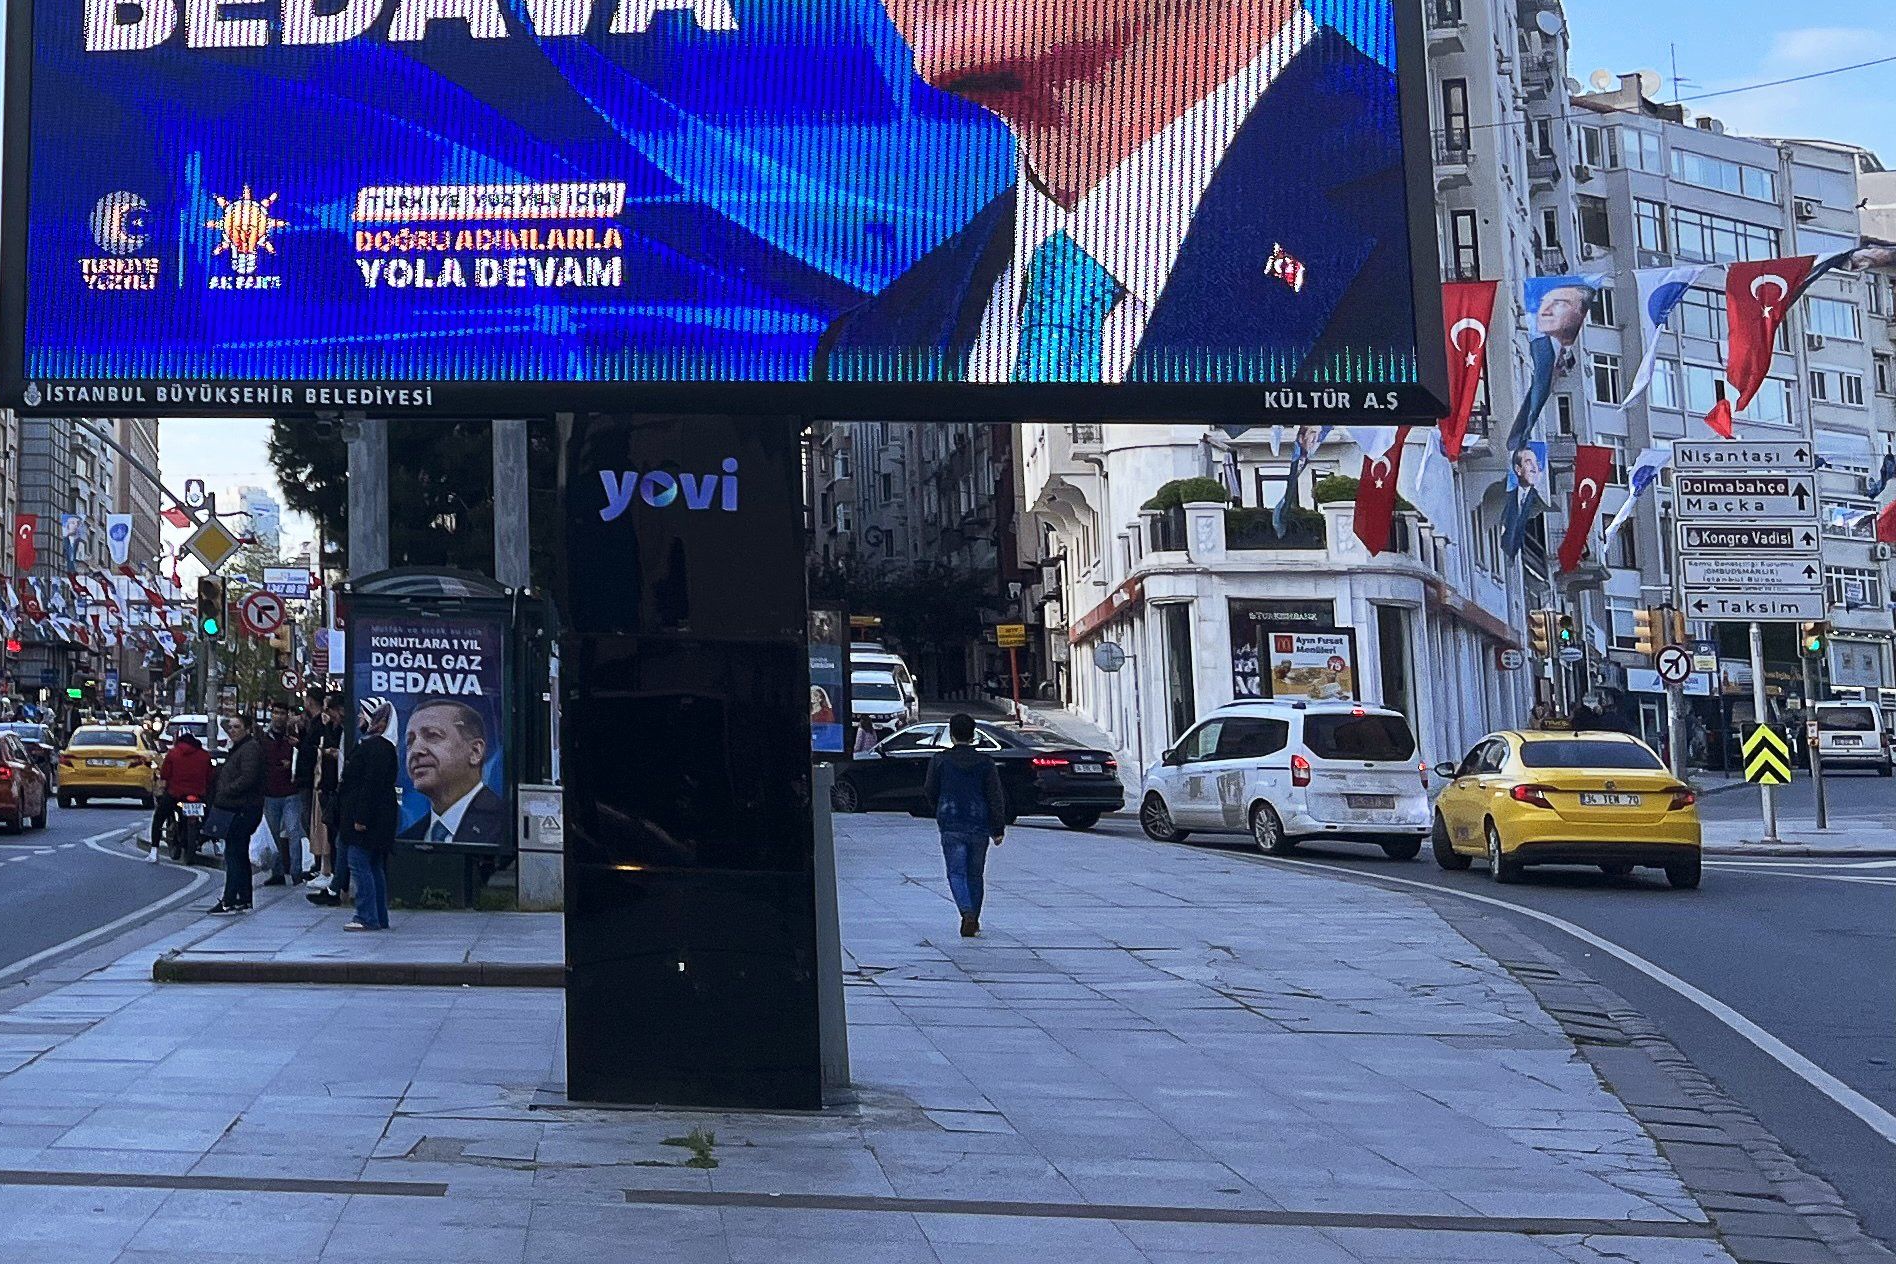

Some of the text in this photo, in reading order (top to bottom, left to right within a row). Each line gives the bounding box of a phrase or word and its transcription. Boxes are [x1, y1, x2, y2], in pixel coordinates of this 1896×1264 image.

[356, 256, 623, 288] YOLA DEVAM
[47, 381, 433, 406] İSTANBUL BÜYÜKŞEHİR BELEDİYESİ
[1264, 388, 1351, 410] KÜLTÜR
[1681, 449, 1781, 464] Nişantaşı
[599, 457, 738, 521] yovi
[1681, 479, 1786, 495] Dolmabahçe
[1686, 498, 1765, 513] Maçka
[1702, 531, 1792, 547] Kongre Vadisi
[1717, 599, 1800, 614] Taksim
[371, 636, 482, 651] KONUTLARA 1 YIL
[371, 650, 483, 671] DOĞAL GAZ
[371, 671, 483, 696] BEDAVA
